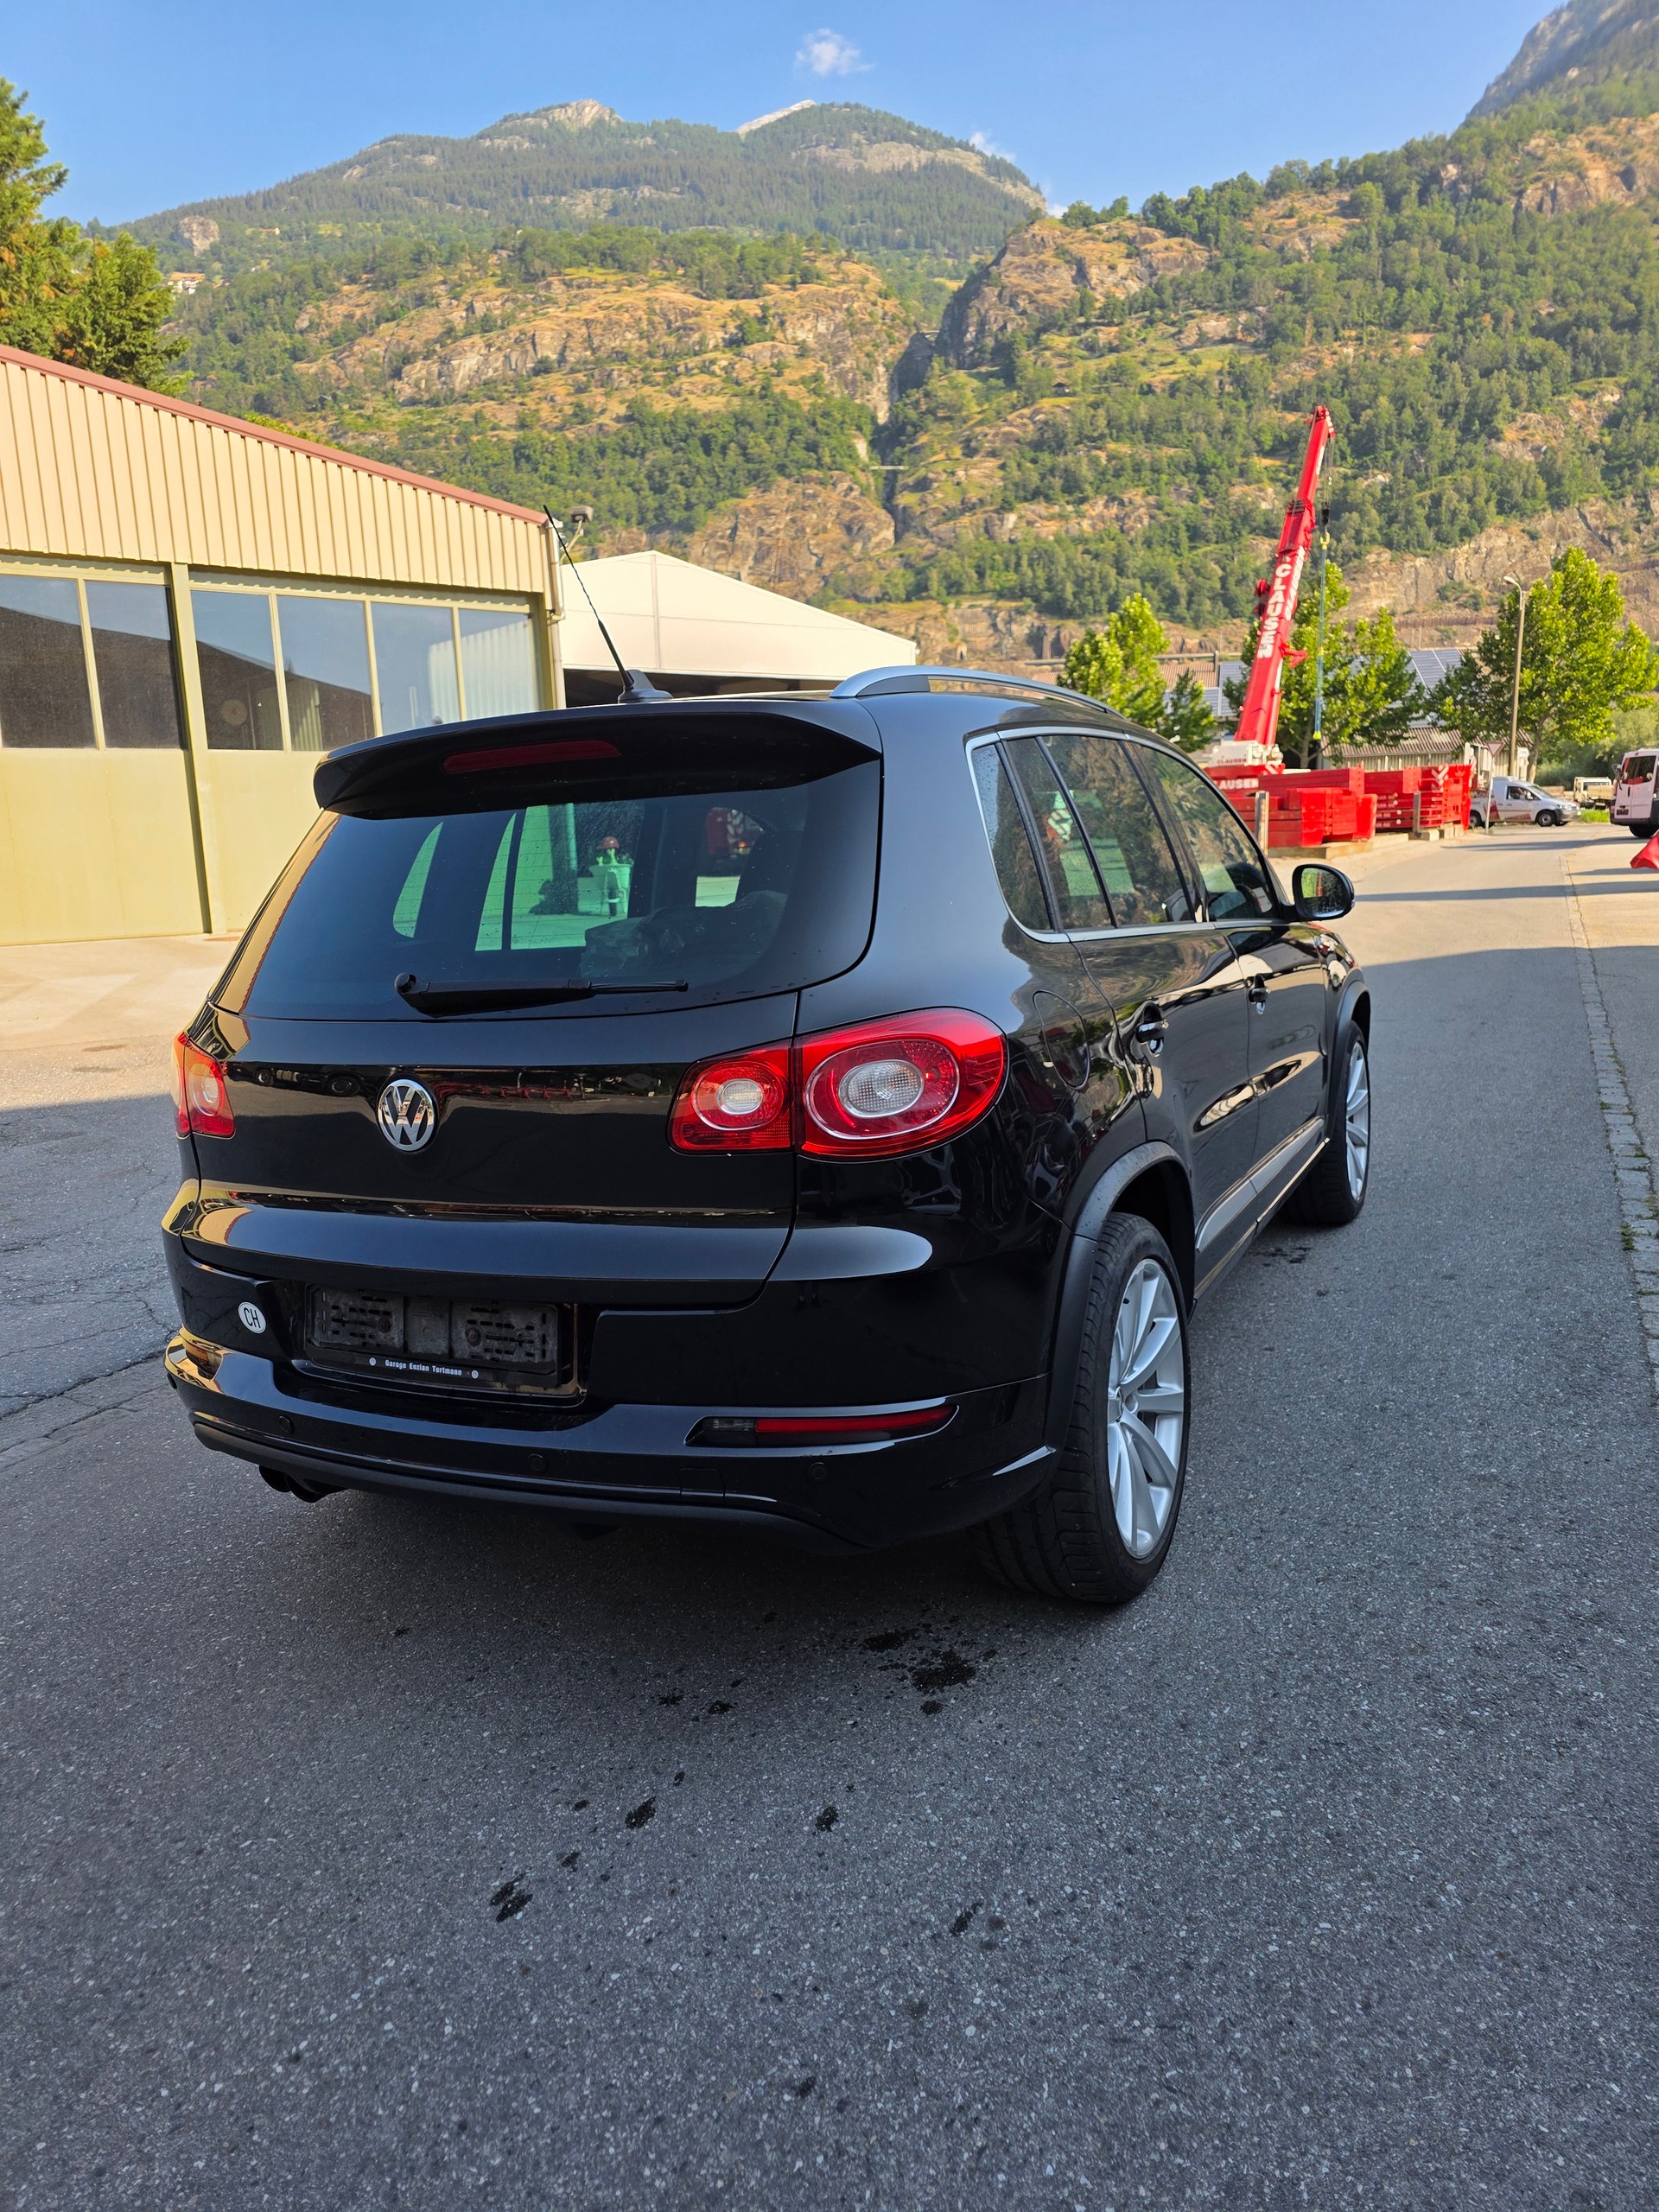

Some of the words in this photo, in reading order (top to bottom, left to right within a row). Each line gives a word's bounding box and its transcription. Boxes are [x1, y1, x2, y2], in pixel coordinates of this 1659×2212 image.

[1257, 563, 1293, 658] CLAUSEN
[378, 1078, 435, 1151] VW
[244, 1307, 261, 1328] CH
[385, 1359, 407, 1370] Garage
[432, 1365, 462, 1376] Turtmann
